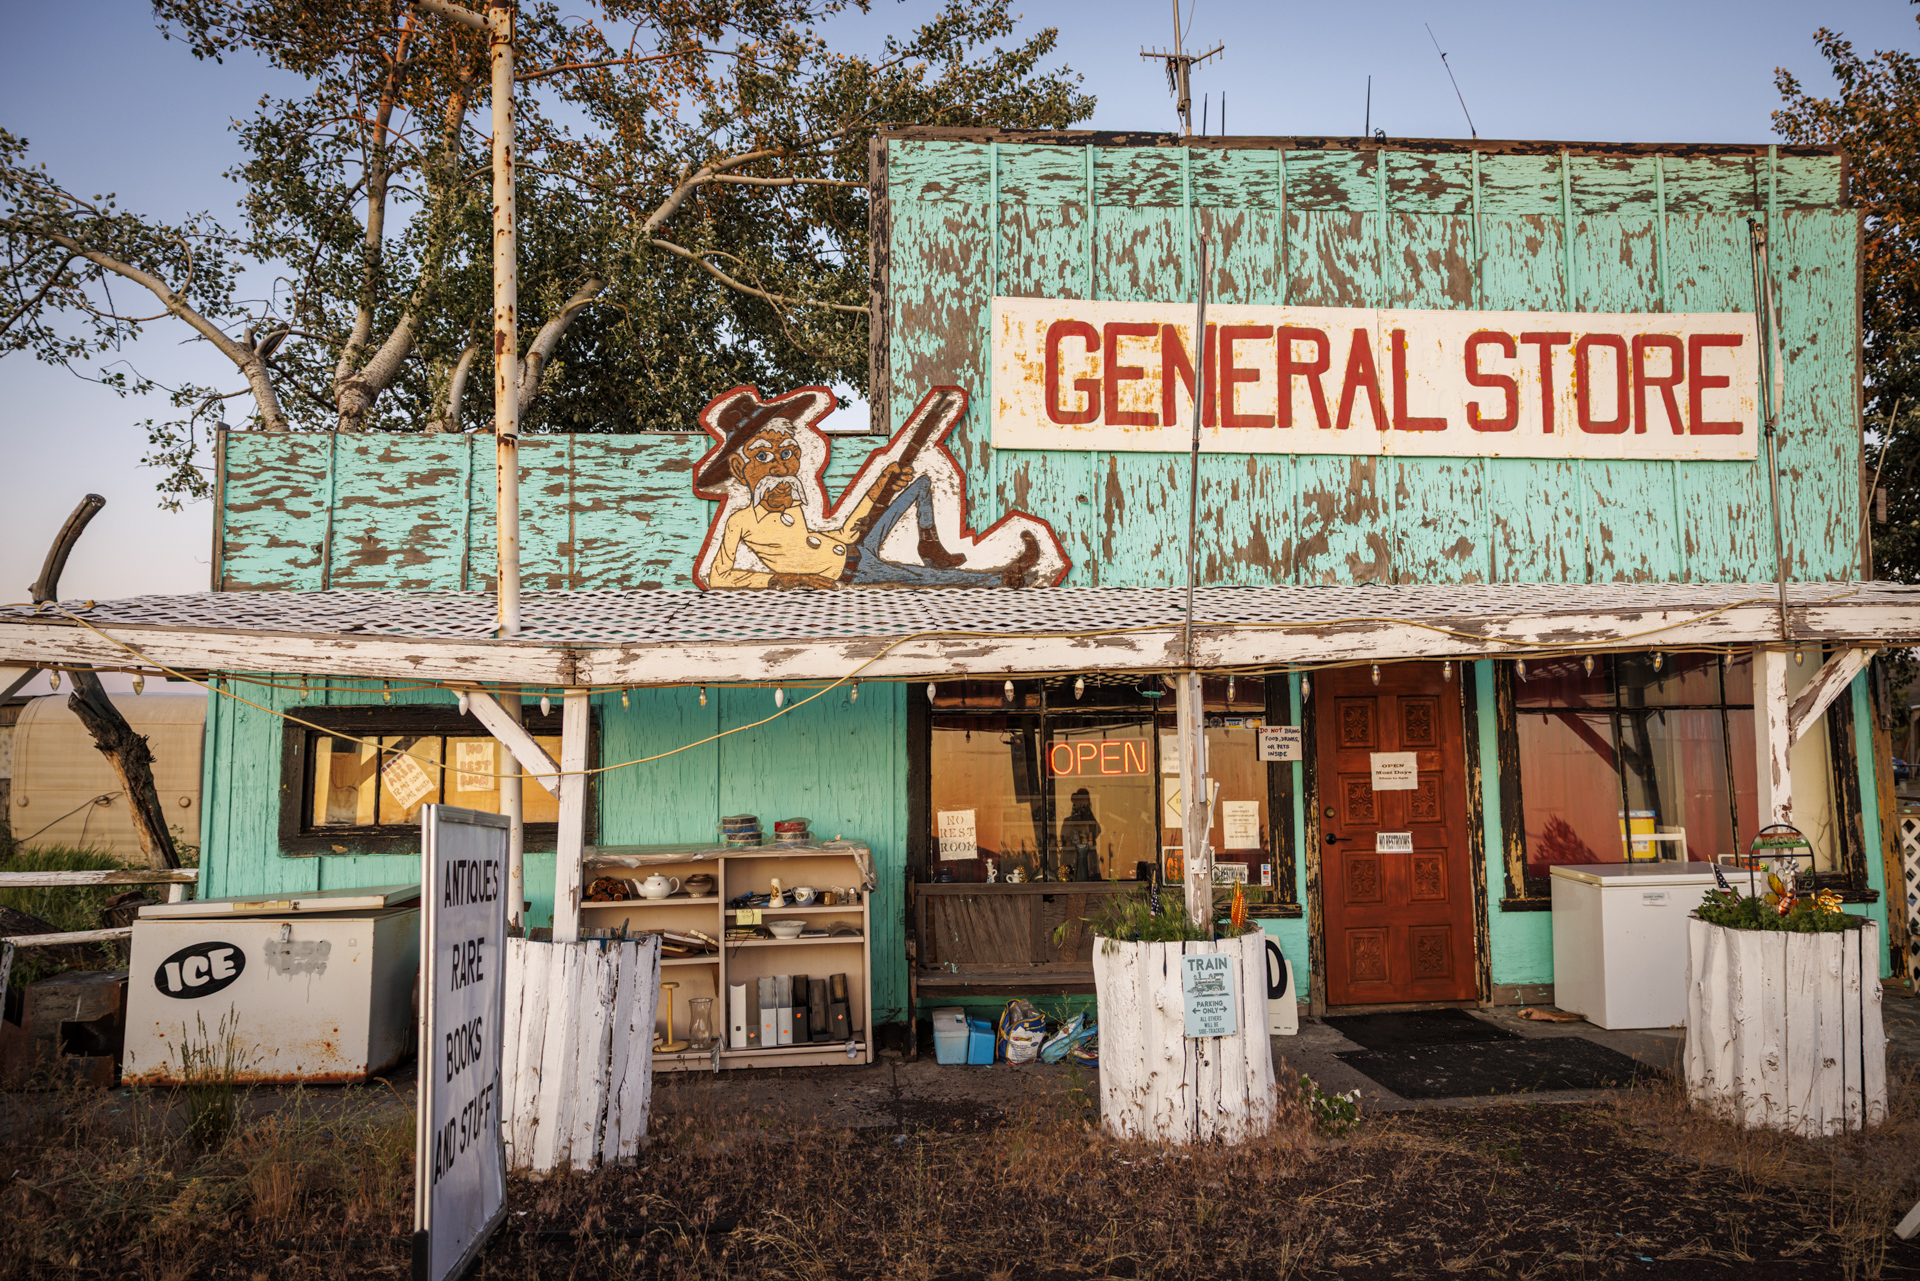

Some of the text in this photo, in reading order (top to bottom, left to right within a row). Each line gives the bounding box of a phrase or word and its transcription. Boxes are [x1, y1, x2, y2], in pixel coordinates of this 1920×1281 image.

[1045, 318, 1744, 436] GENERAL STORE
[465, 743, 483, 756] NO
[1051, 741, 1146, 775] OPEN
[389, 763, 416, 787] AREA
[400, 781, 410, 791] MI
[460, 774, 489, 787] ROOM
[406, 791, 417, 800] MI
[415, 779, 431, 793] NORTH
[946, 815, 964, 826] NO
[940, 827, 975, 838] REST
[940, 842, 978, 852] ROOM
[444, 859, 499, 908] ANTIQUES
[165, 947, 237, 992] ICE
[451, 937, 485, 992] RARE
[1187, 957, 1228, 972] TRAIN
[446, 1016, 483, 1083] BOOKS
[434, 1083, 493, 1185] AND STUFF
